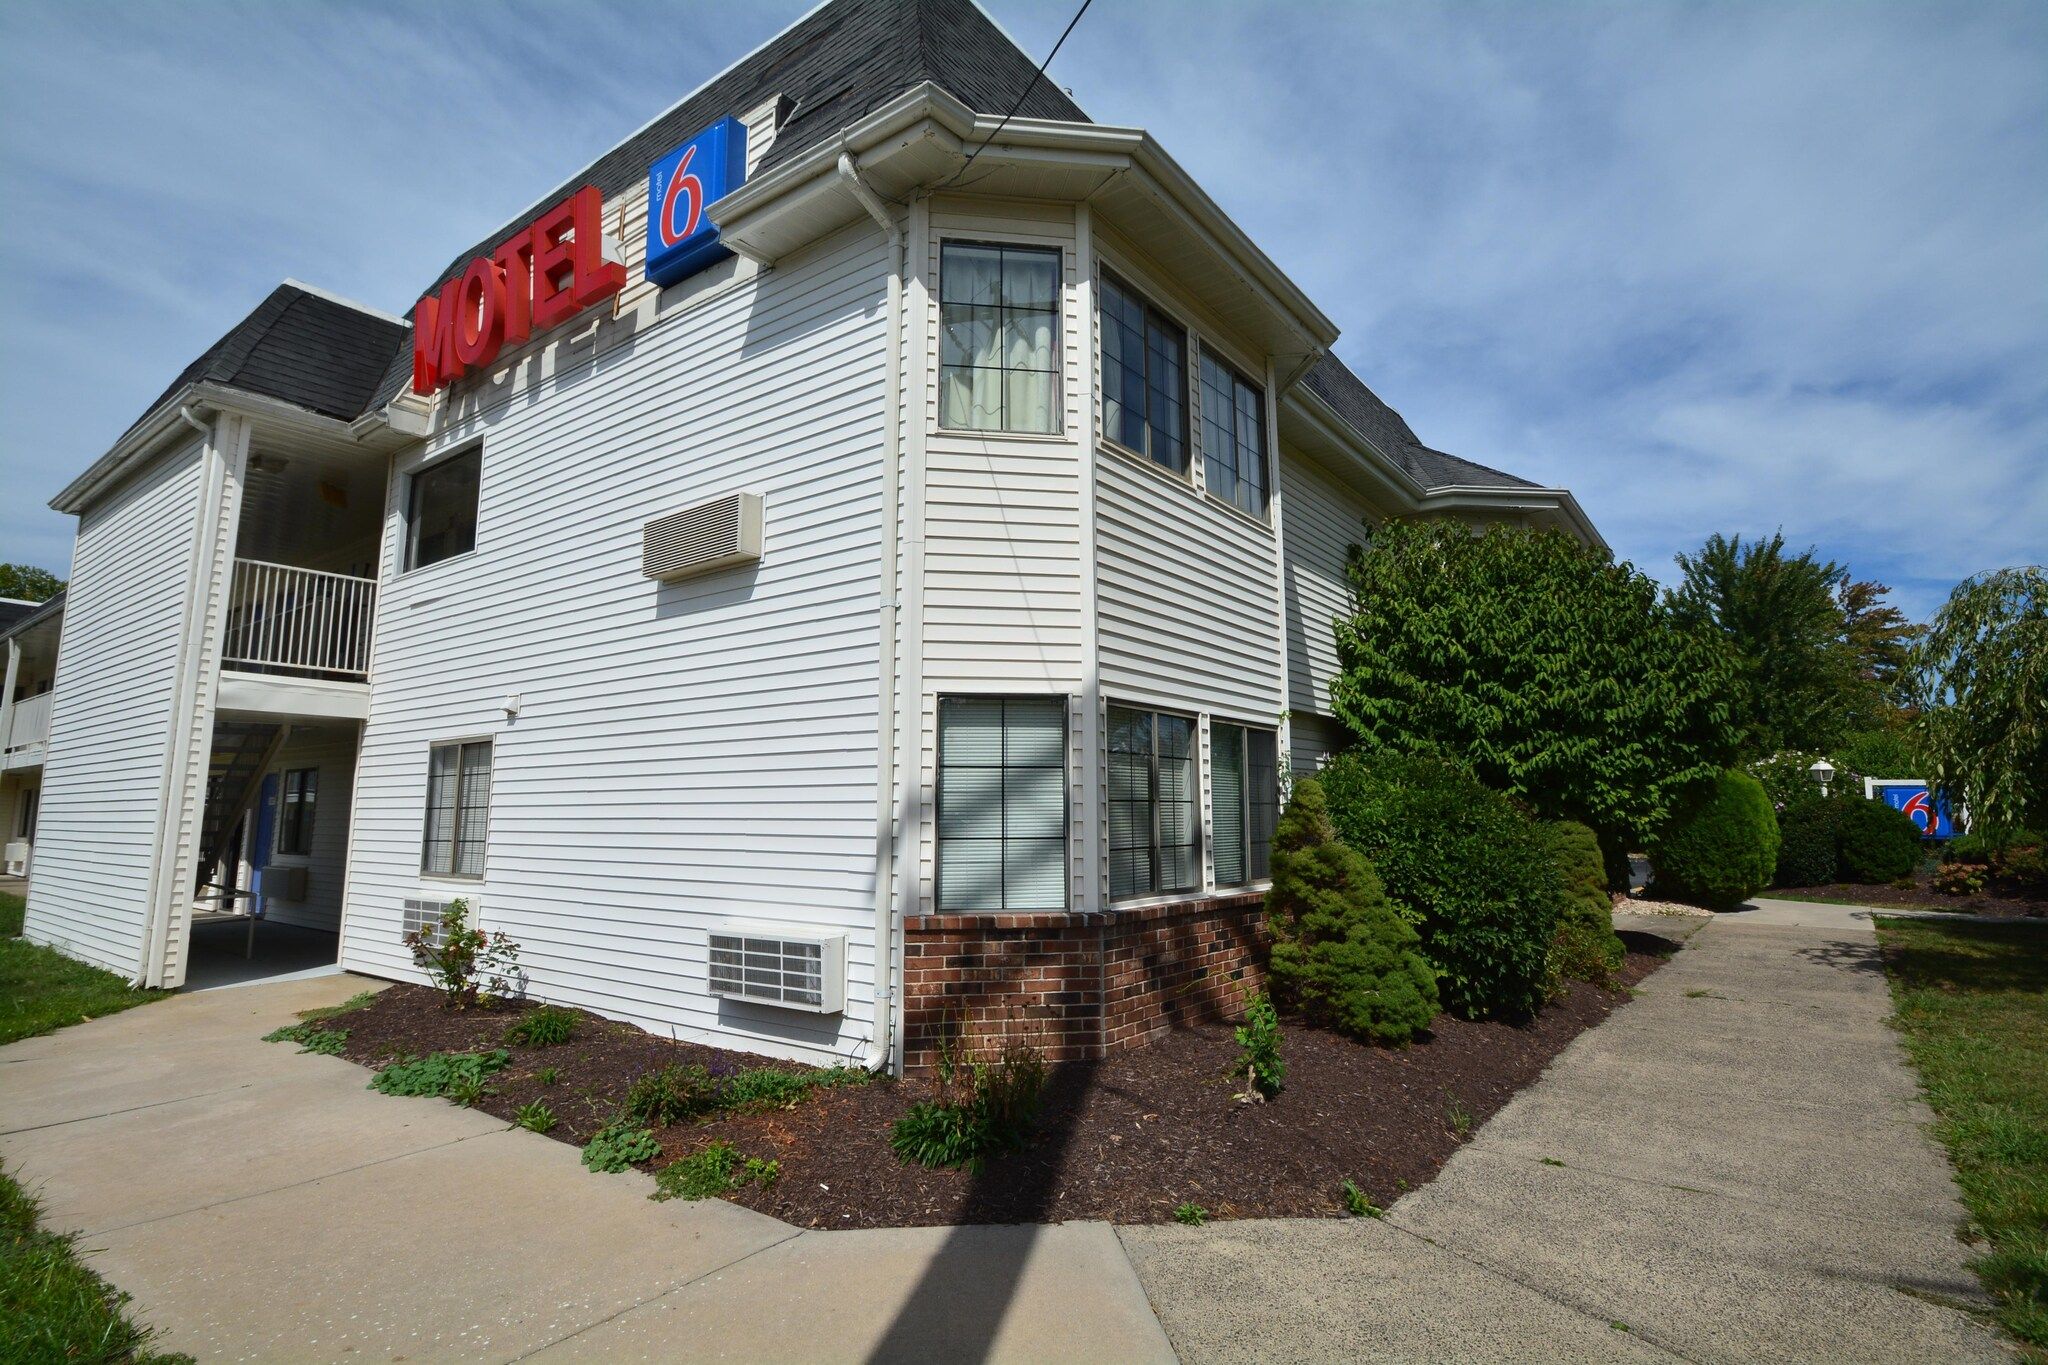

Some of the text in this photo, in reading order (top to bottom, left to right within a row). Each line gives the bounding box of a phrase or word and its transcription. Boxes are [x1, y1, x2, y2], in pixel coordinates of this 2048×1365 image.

[659, 144, 704, 248] 6
[413, 184, 627, 396] MOTEL
[1901, 791, 1939, 835] 6
